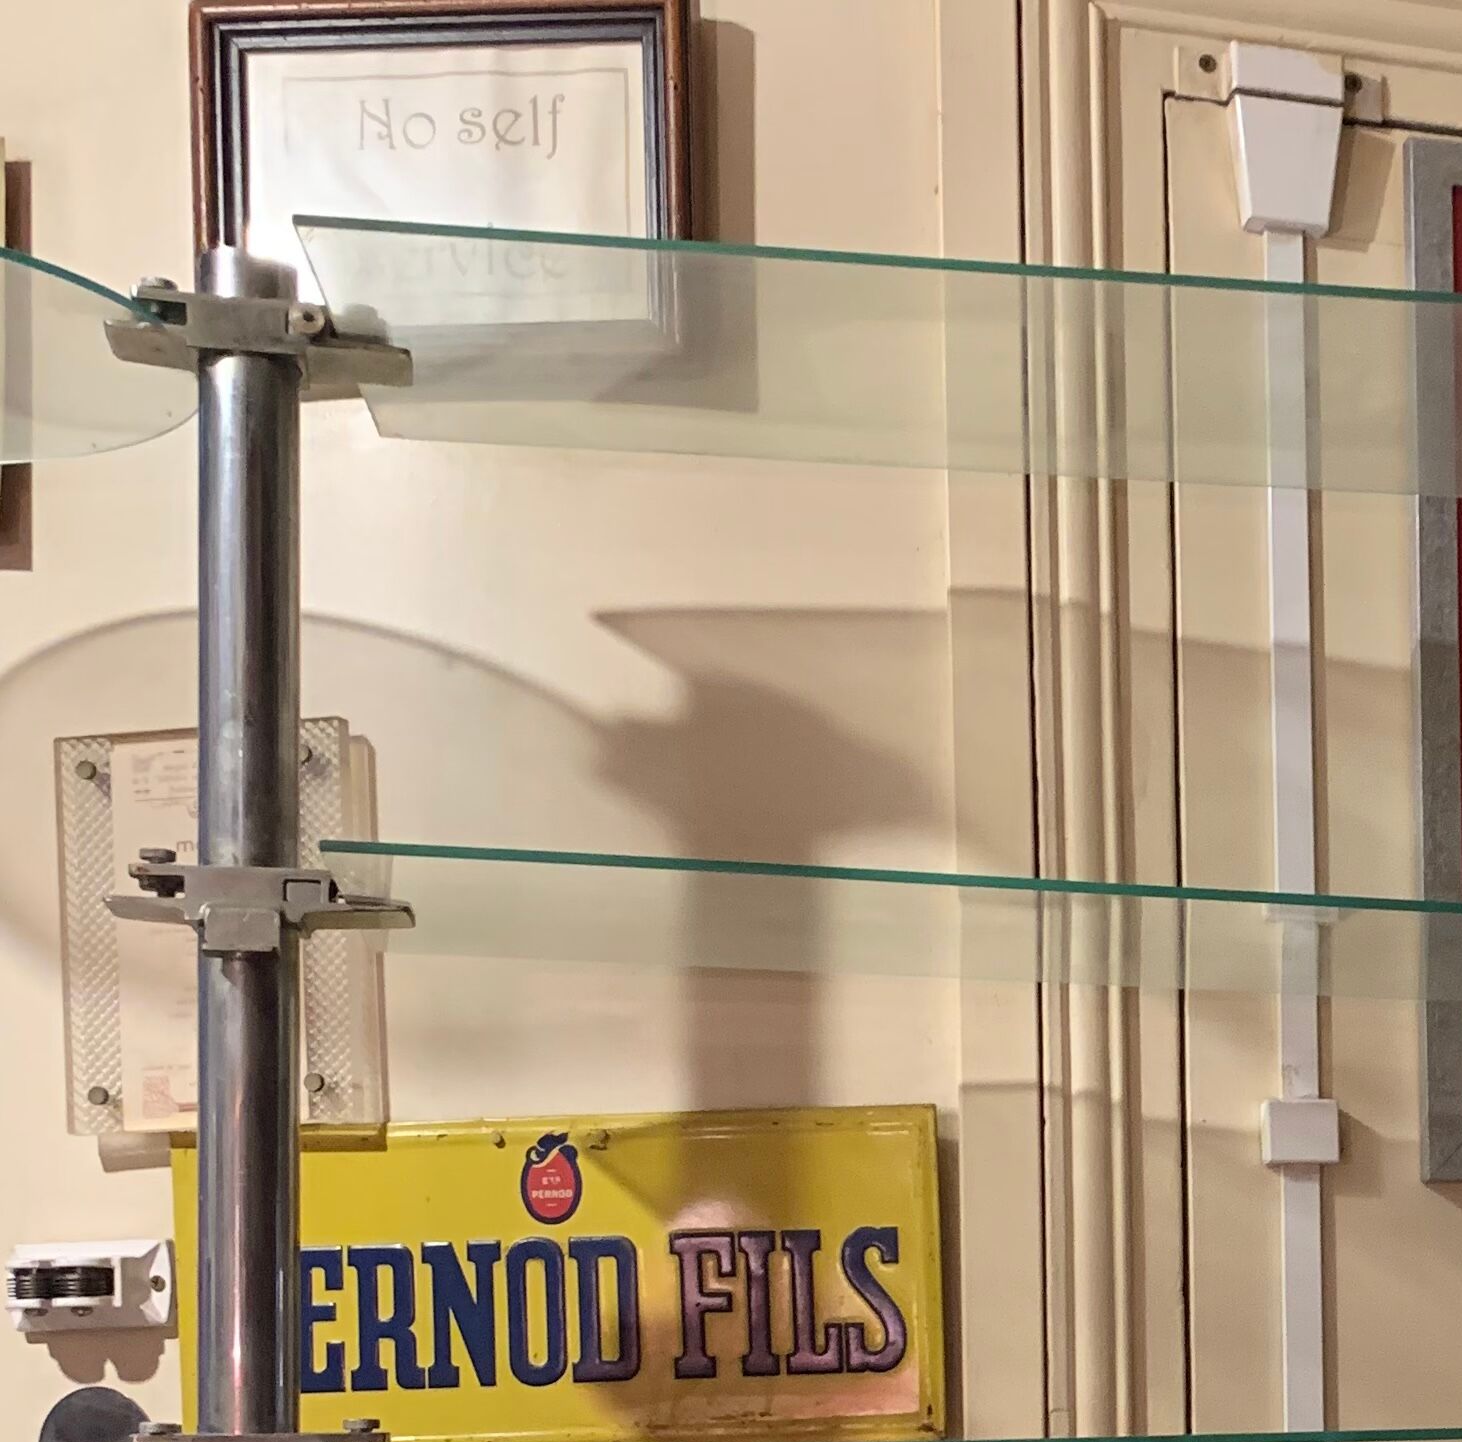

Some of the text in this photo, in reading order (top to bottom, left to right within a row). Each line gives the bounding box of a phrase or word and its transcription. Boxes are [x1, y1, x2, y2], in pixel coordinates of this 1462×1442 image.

[359, 93, 566, 159] No self
[299, 1225, 908, 1394] ERNOD FILS
